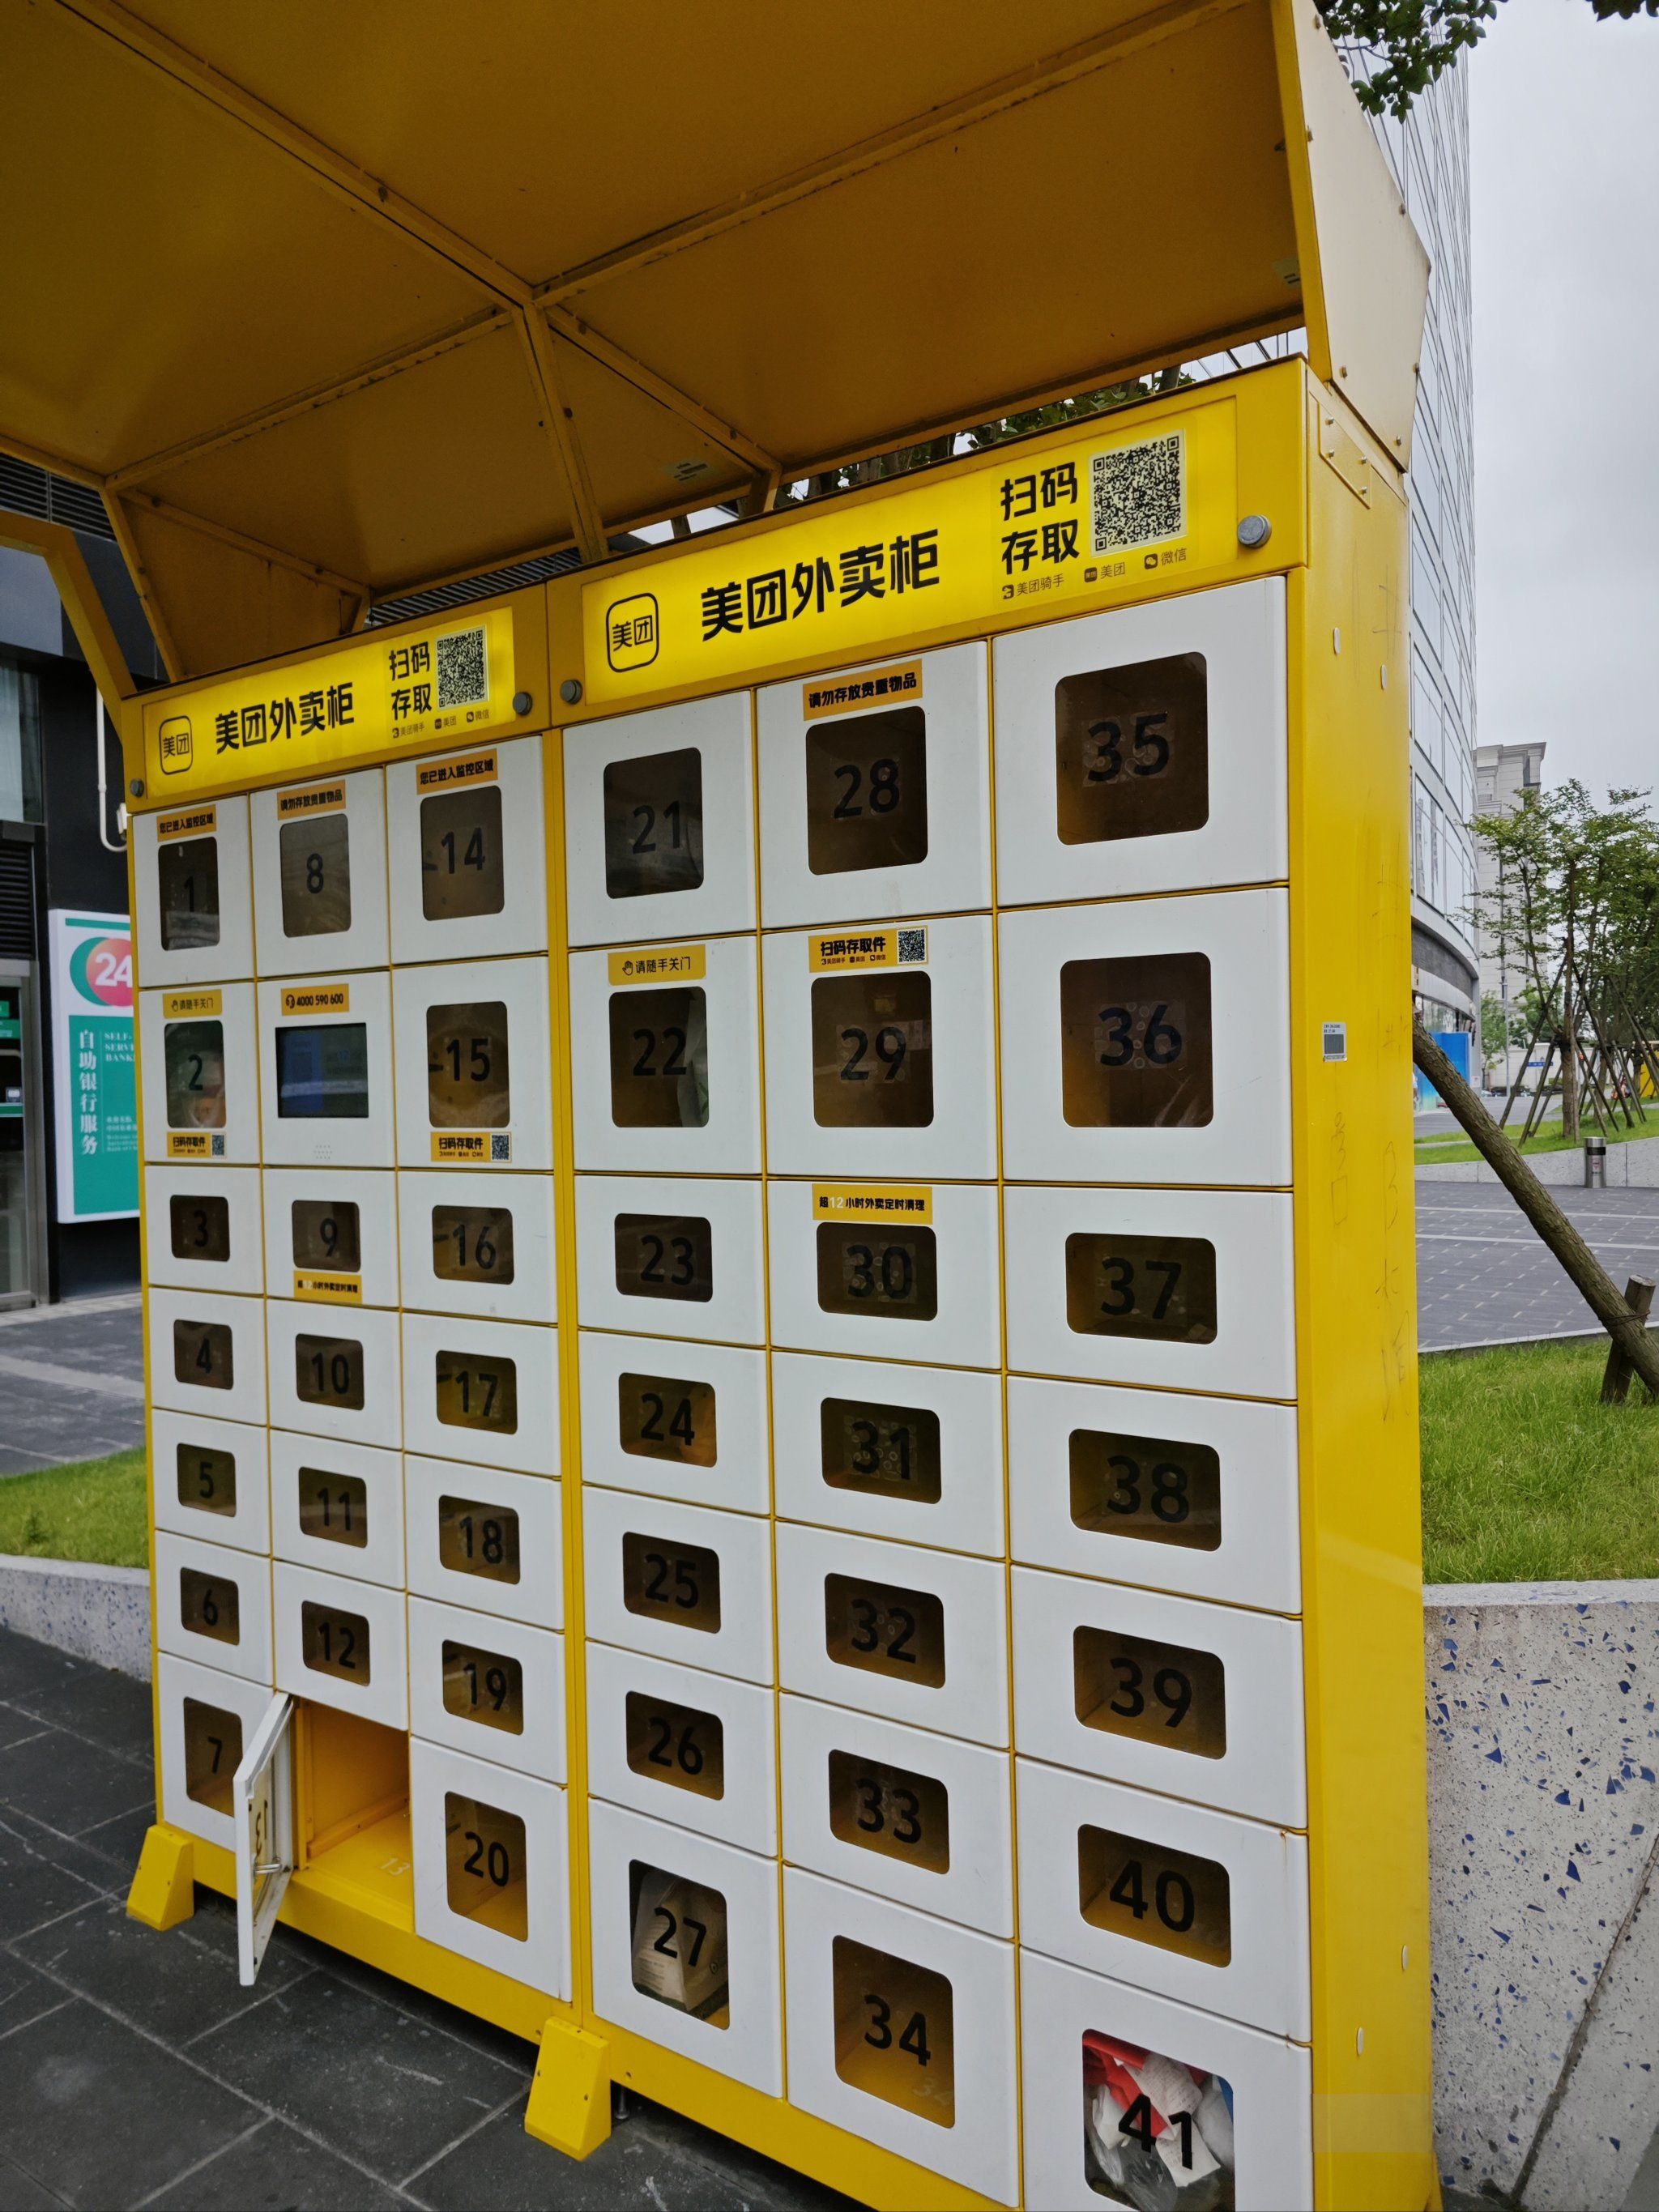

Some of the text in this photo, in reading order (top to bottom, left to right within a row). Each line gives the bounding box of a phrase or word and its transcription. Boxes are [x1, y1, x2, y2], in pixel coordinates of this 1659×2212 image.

[1000, 462, 1079, 520] 扫码
[1001, 521, 1080, 575] 存取
[701, 528, 940, 642] 美团外卖柜
[1017, 573, 1064, 596] 美团骑手
[1101, 562, 1125, 579] 美团
[1161, 548, 1188, 566] 微信
[612, 615, 653, 652] 美团
[389, 641, 430, 681] 扫码
[391, 684, 433, 721] 存取
[808, 672, 917, 708] 请勿存放贵重物品
[215, 681, 354, 755] 美团外卖柜
[443, 716, 457, 727] 美团
[476, 710, 489, 721] 微信
[162, 732, 190, 757] 美团
[1088, 713, 1170, 782] 35
[420, 759, 493, 785] 您已进入监控区域
[833, 758, 900, 819] 28
[160, 812, 214, 833] 您已进入监控区域
[632, 800, 680, 854] 21
[306, 853, 324, 893] 8
[441, 827, 485, 874] 14
[184, 876, 195, 912] 1
[636, 957, 691, 974] 请随手关门
[821, 936, 886, 957] 扫码存取件
[95, 953, 133, 988] 24
[296, 993, 343, 1006] 4000 590 600
[633, 1026, 687, 1076] 22
[841, 1027, 906, 1080] 29
[1098, 1004, 1182, 1067] 36
[188, 1055, 203, 1091] 2
[446, 1038, 491, 1082] 15
[79, 1029, 98, 1155] 自助银行服务
[438, 1137, 484, 1149] 扫码存取件
[819, 1196, 925, 1211] 超12小时外卖定时清理
[194, 1210, 209, 1247] 3
[320, 1217, 339, 1257] 9
[452, 1224, 497, 1270] 16
[641, 1235, 694, 1285] 23
[847, 1244, 912, 1299] 30
[1102, 1257, 1182, 1320] 37
[196, 1338, 212, 1375] 4
[312, 1352, 349, 1395] 10
[456, 1370, 498, 1417] 17
[641, 1393, 695, 1445] 24
[852, 1420, 911, 1480] 31
[198, 1461, 215, 1499] 5
[1107, 1455, 1189, 1524] 38
[317, 1487, 352, 1531] 11
[459, 1516, 503, 1564] 18
[645, 1553, 698, 1609] 25
[203, 1588, 218, 1626] 6
[318, 1622, 356, 1669] 12
[851, 1599, 917, 1664] 32
[463, 1663, 507, 1711] 19
[1110, 1658, 1192, 1728] 39
[208, 1736, 222, 1773] 7
[647, 1717, 703, 1775] 26
[855, 1779, 922, 1844] 33
[464, 1831, 509, 1887] 20
[1109, 1859, 1195, 1932] 40
[654, 1907, 707, 1967] 27
[864, 1994, 931, 2067] 34
[1119, 2094, 1192, 2170] 41
